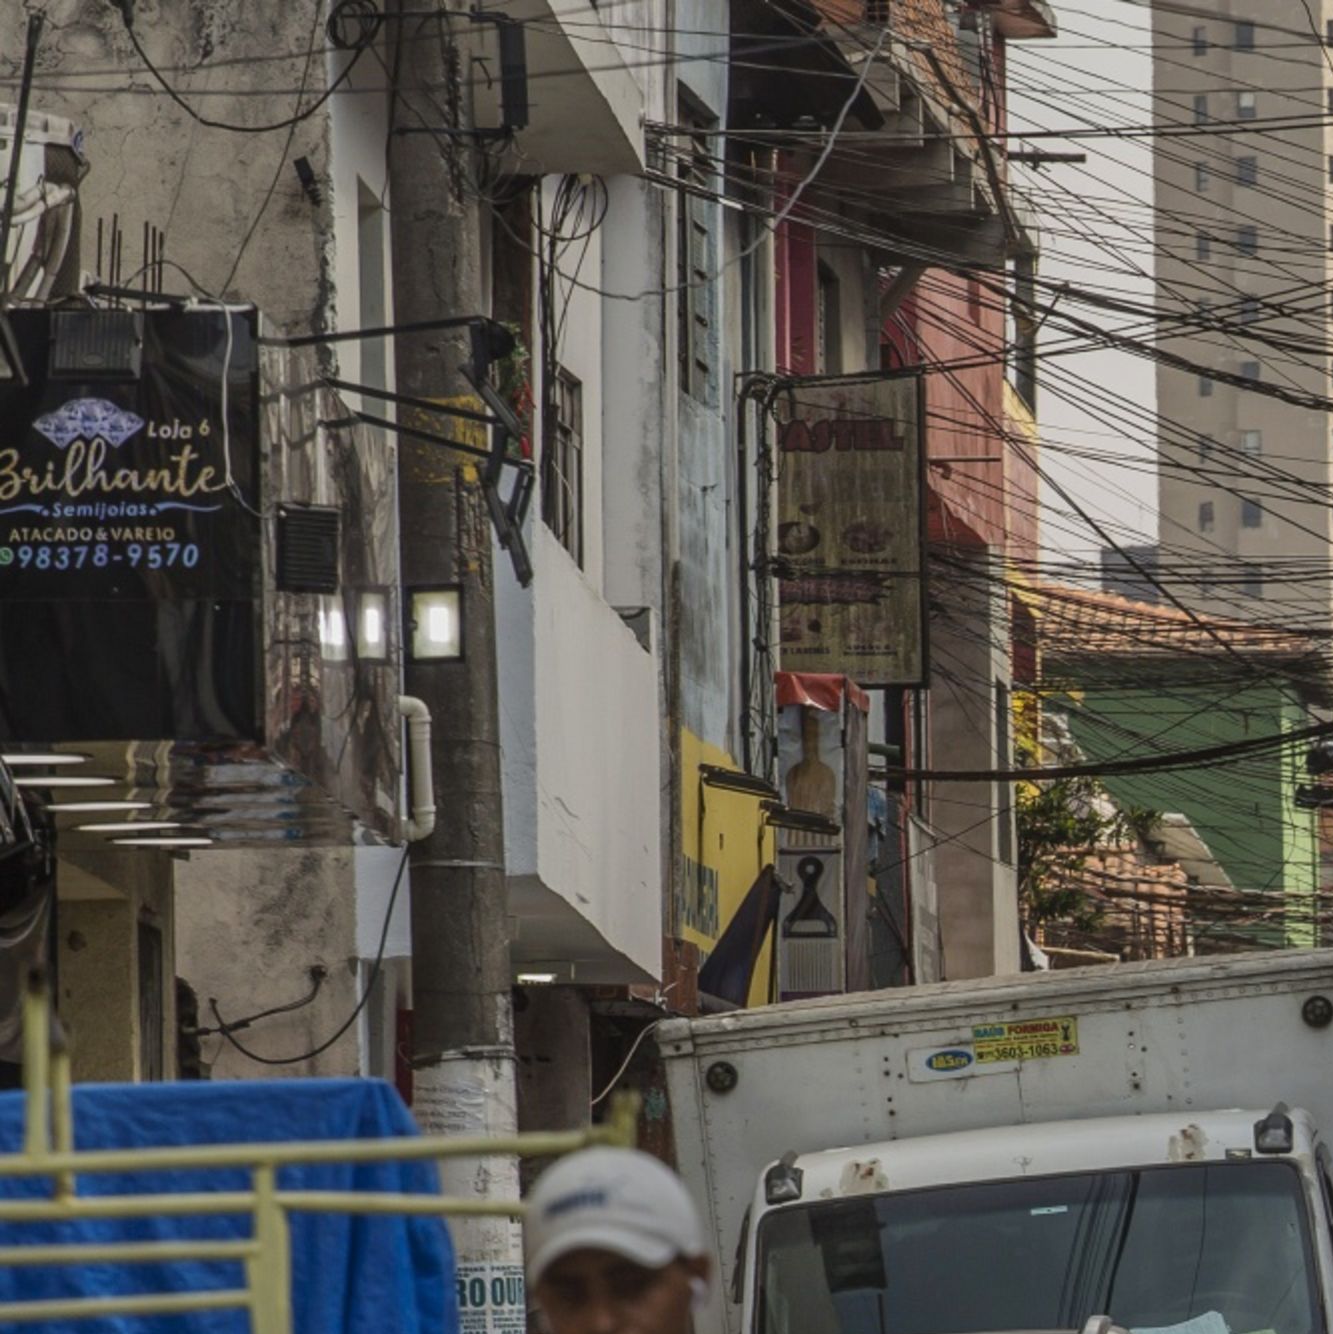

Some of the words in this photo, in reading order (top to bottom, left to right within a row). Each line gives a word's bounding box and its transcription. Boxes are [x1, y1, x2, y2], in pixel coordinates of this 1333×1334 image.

[148, 417, 192, 440] Loja
[198, 419, 211, 436] 6
[777, 418, 904, 453] ASTEL
[0, 436, 227, 500] Brilhante
[51, 501, 148, 520] Semijoias
[9, 527, 93, 543] ATACADO
[95, 528, 109, 542] &
[17, 543, 199, 570] 98378-9570
[457, 1278, 486, 1308] RO
